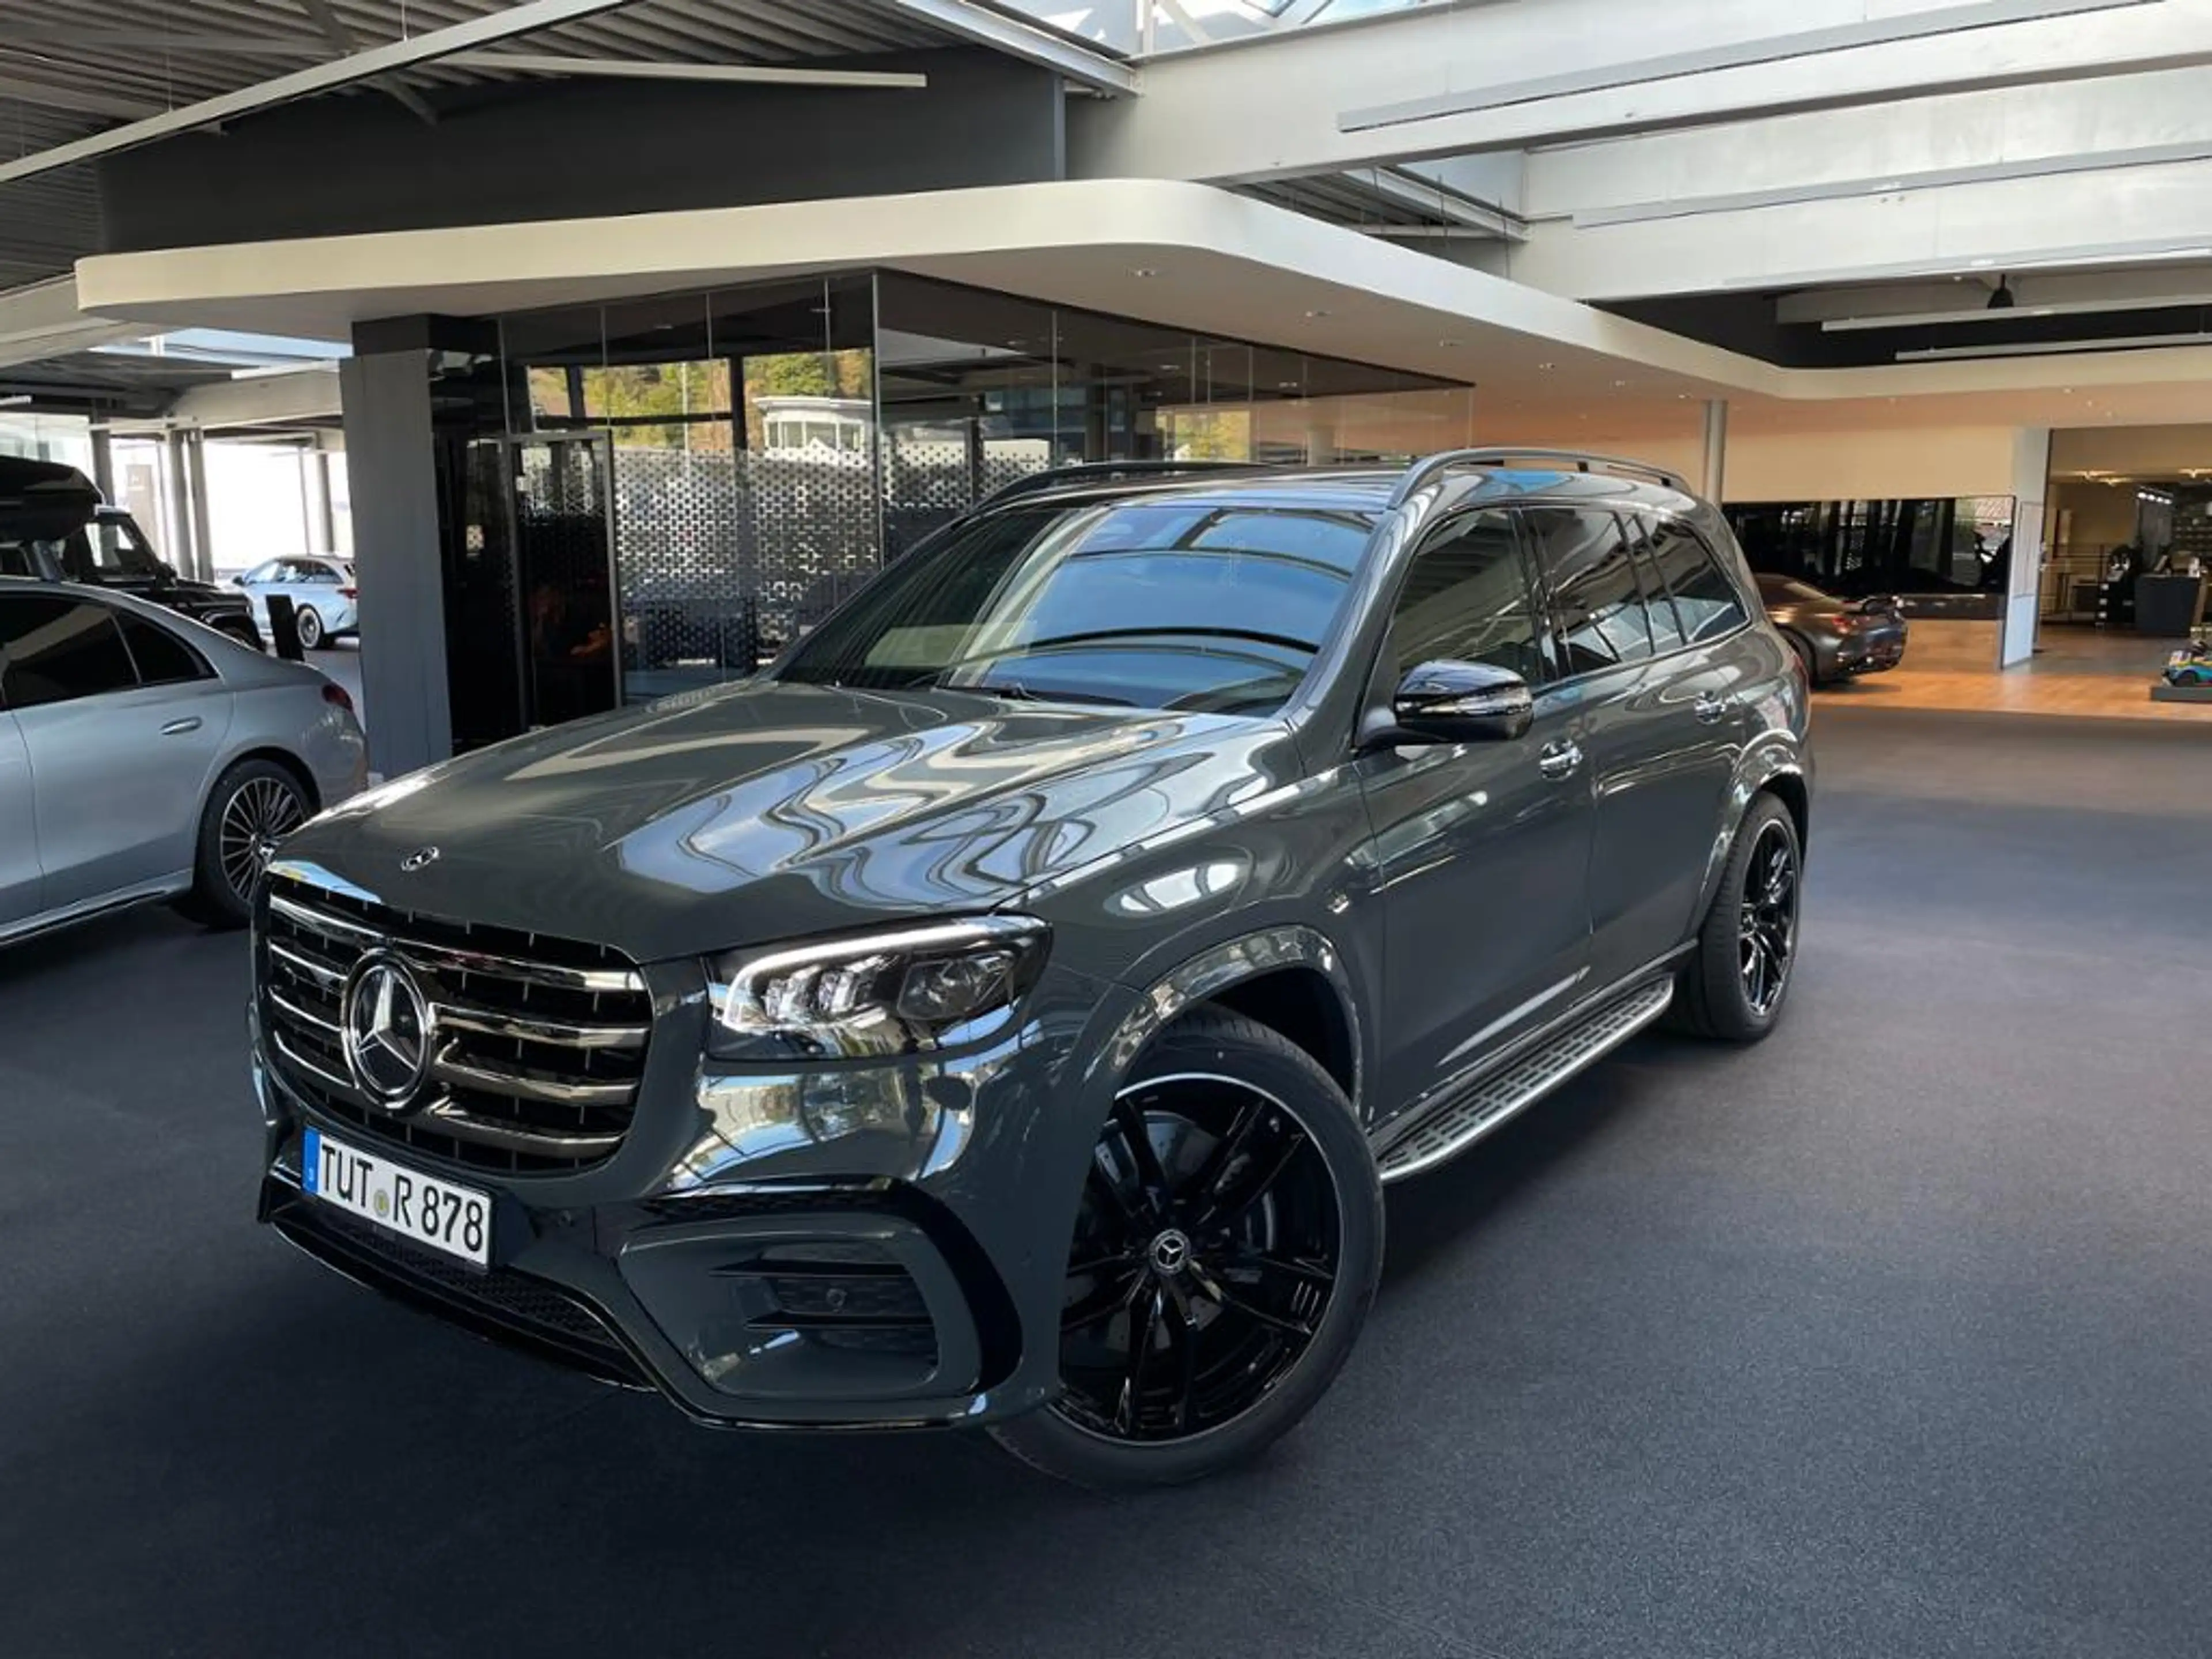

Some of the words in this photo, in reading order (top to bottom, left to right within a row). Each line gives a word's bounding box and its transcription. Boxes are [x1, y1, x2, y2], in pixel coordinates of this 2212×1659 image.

[321, 1144, 373, 1208] TUT
[393, 1173, 412, 1228] R
[421, 1185, 483, 1252] 878
